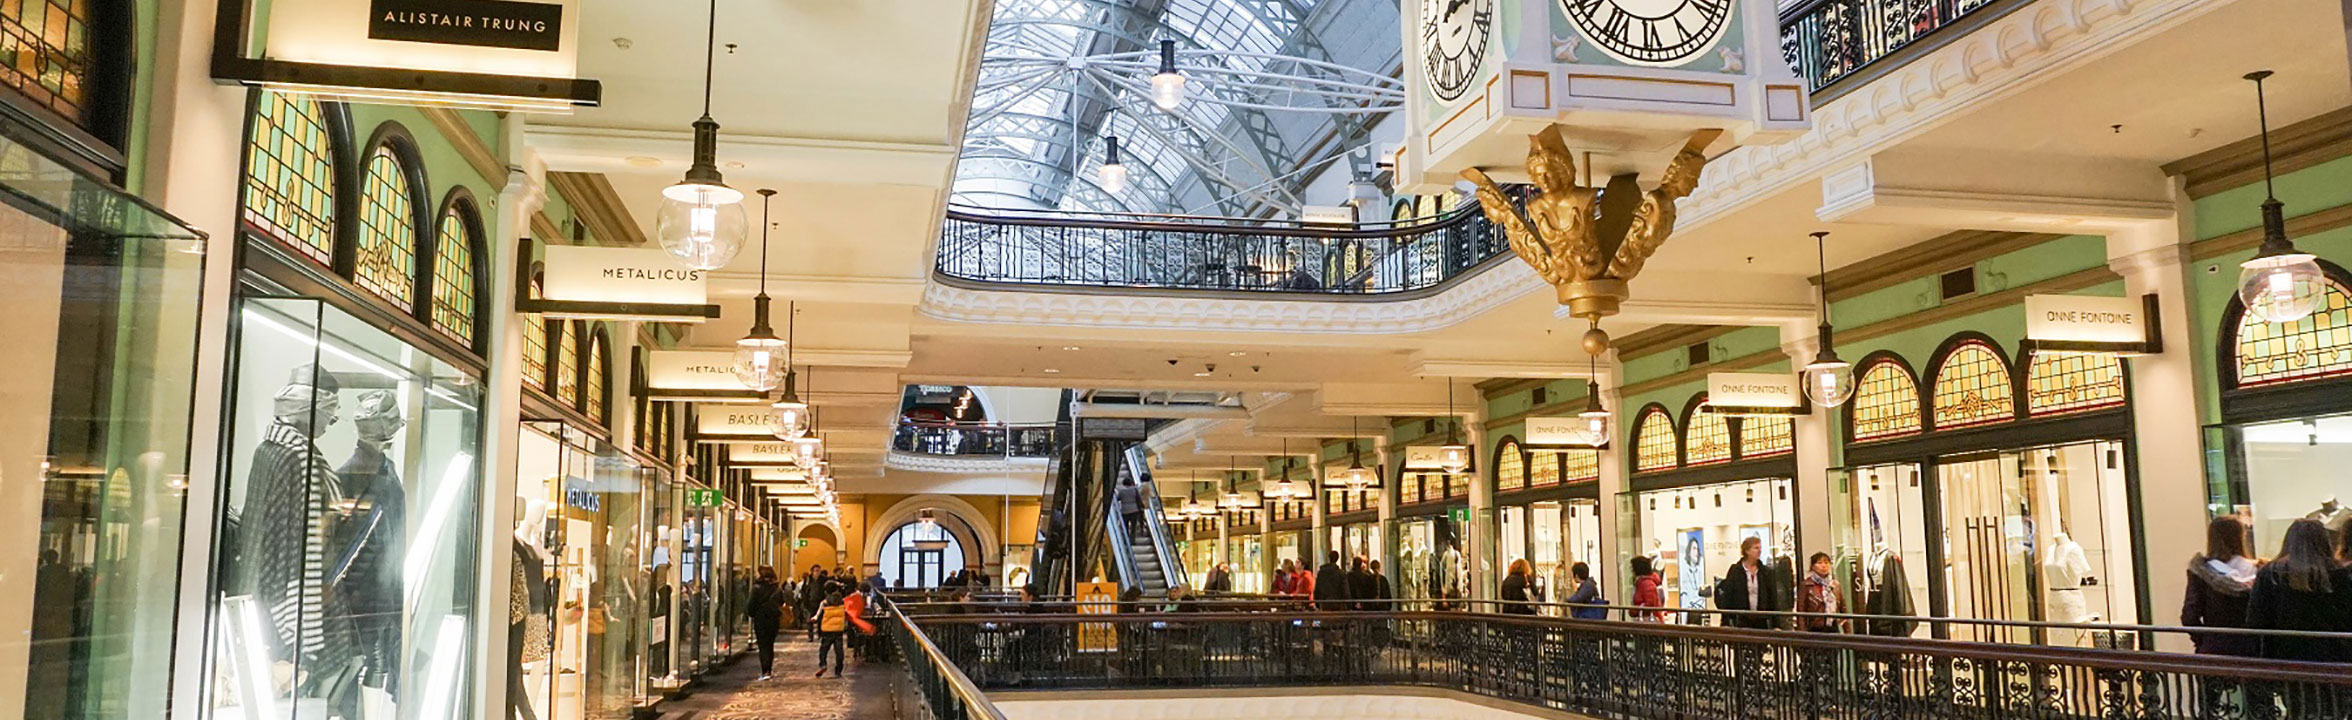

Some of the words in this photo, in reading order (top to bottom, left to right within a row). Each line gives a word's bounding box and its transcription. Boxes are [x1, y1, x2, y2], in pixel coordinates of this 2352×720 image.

[384, 11, 472, 28] ALISTAIR
[482, 17, 546, 33] TRUNG
[603, 268, 698, 281] METALICUS
[686, 366, 737, 374] METALIC
